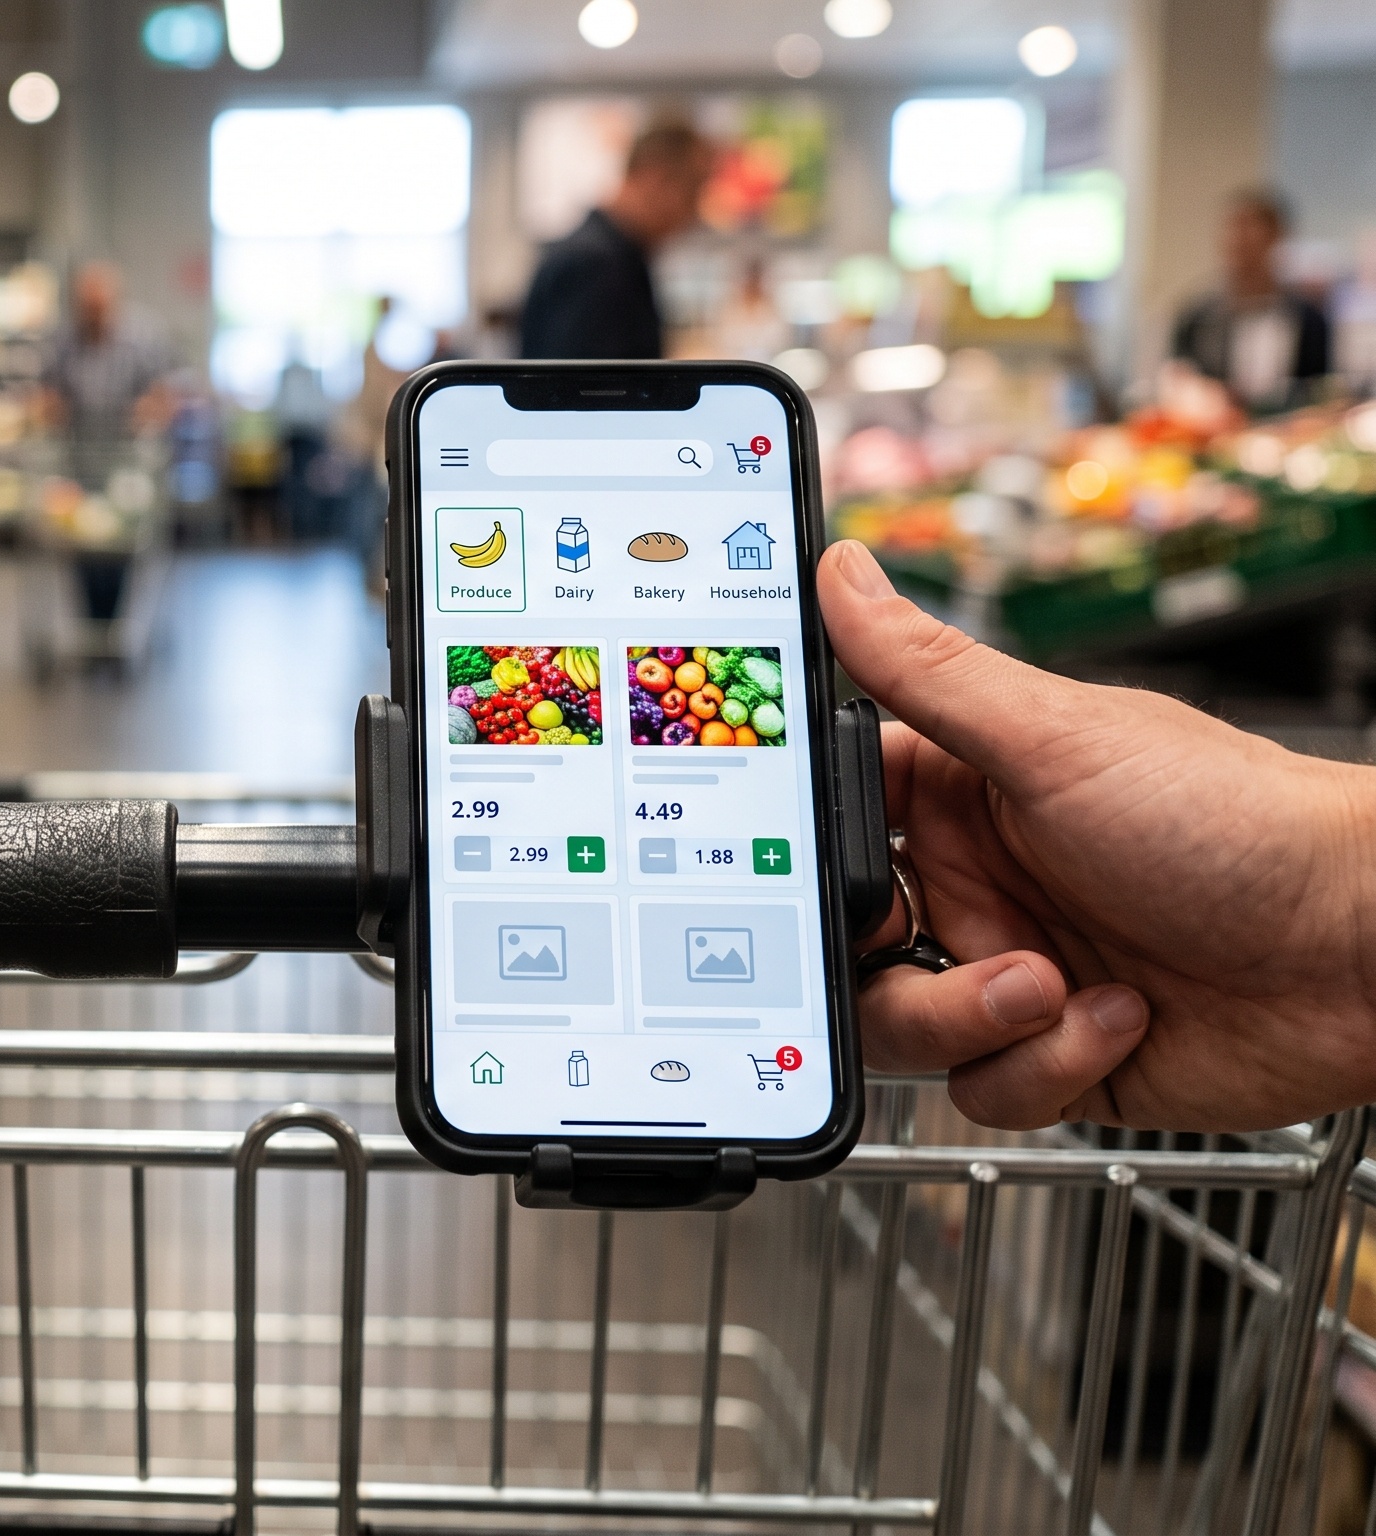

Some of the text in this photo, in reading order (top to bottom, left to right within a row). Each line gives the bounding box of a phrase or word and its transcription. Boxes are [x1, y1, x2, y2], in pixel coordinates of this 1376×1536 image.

[755, 439, 766, 453] 5
[450, 585, 512, 599] Produce
[554, 585, 595, 602] Dairy
[633, 585, 686, 603] Bakery
[710, 585, 792, 599] Household
[451, 800, 500, 819] 2.99
[634, 802, 683, 821] 4.49
[509, 846, 549, 862] 2.99
[695, 848, 734, 865] 1.88
[783, 1050, 795, 1067] 5
